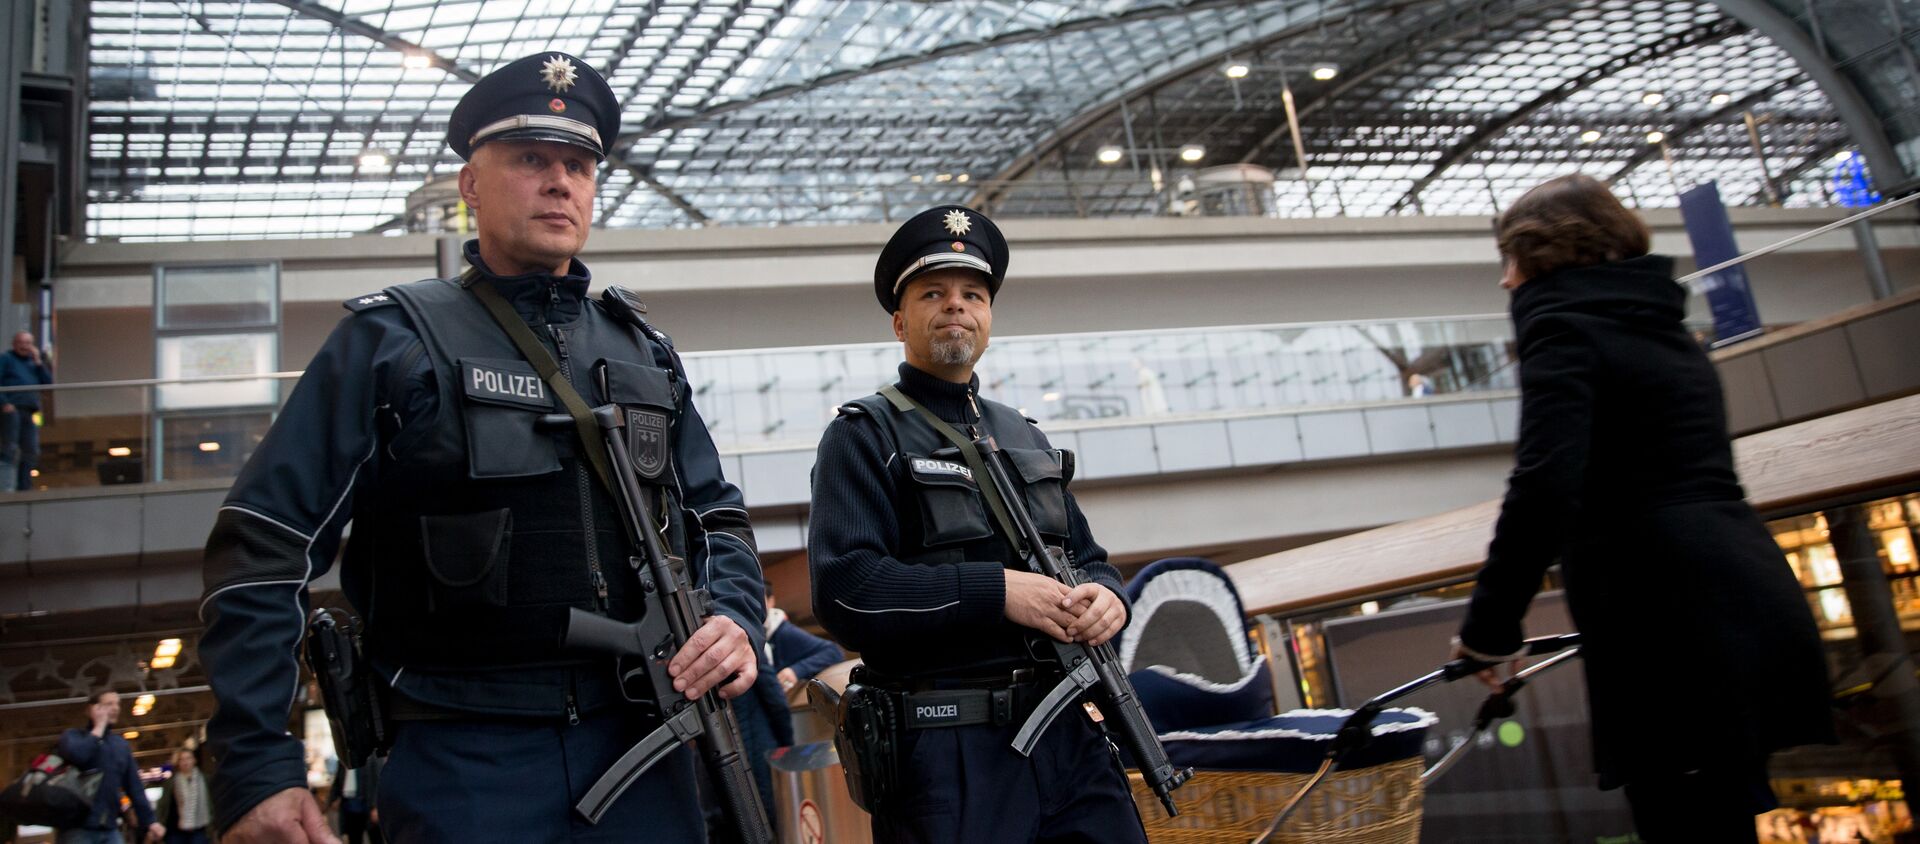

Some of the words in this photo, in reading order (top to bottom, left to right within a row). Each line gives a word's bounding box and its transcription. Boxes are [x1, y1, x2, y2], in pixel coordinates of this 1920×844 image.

[472, 367, 545, 399] POLIZEI
[632, 412, 664, 428] POLIZEI
[915, 460, 973, 478] POLIZEI
[916, 704, 958, 719] POLIZEI
